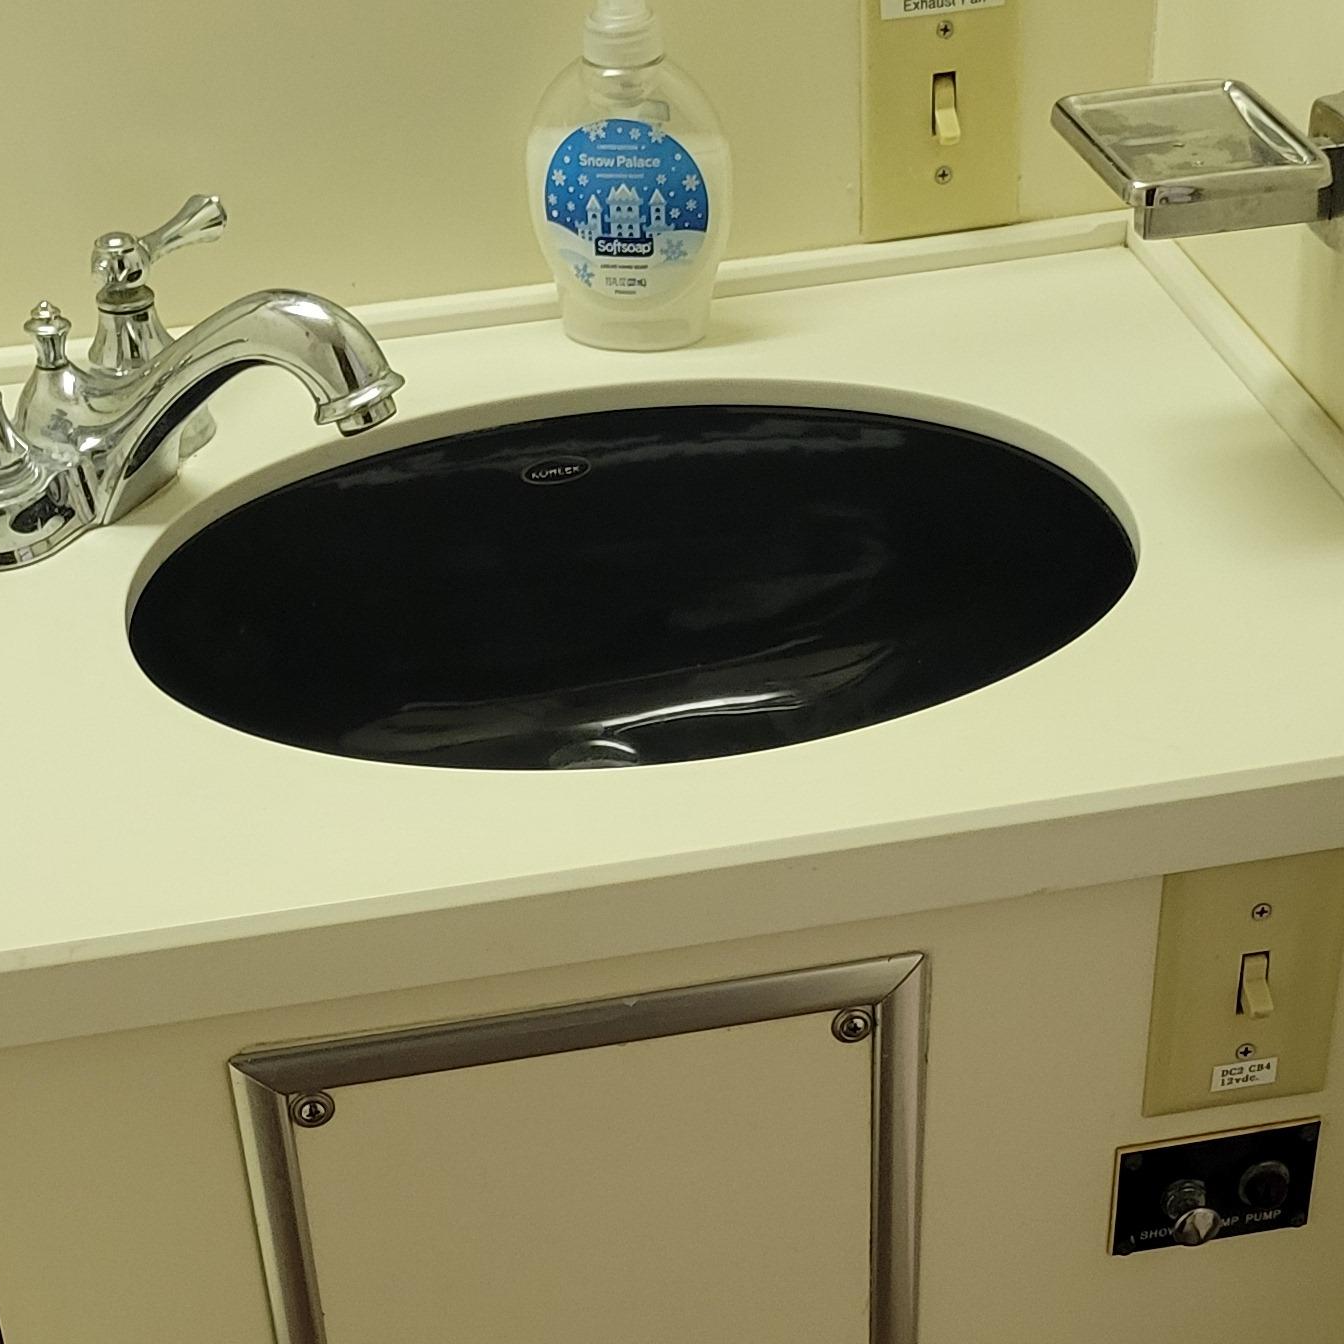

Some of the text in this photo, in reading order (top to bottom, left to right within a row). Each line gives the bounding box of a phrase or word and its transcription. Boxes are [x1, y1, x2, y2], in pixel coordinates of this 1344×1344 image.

[578, 153, 662, 169] Snow Palace
[597, 239, 652, 255] Softsoap
[1248, 1061, 1272, 1073] CB4
[1245, 1208, 1283, 1225] PUMP
